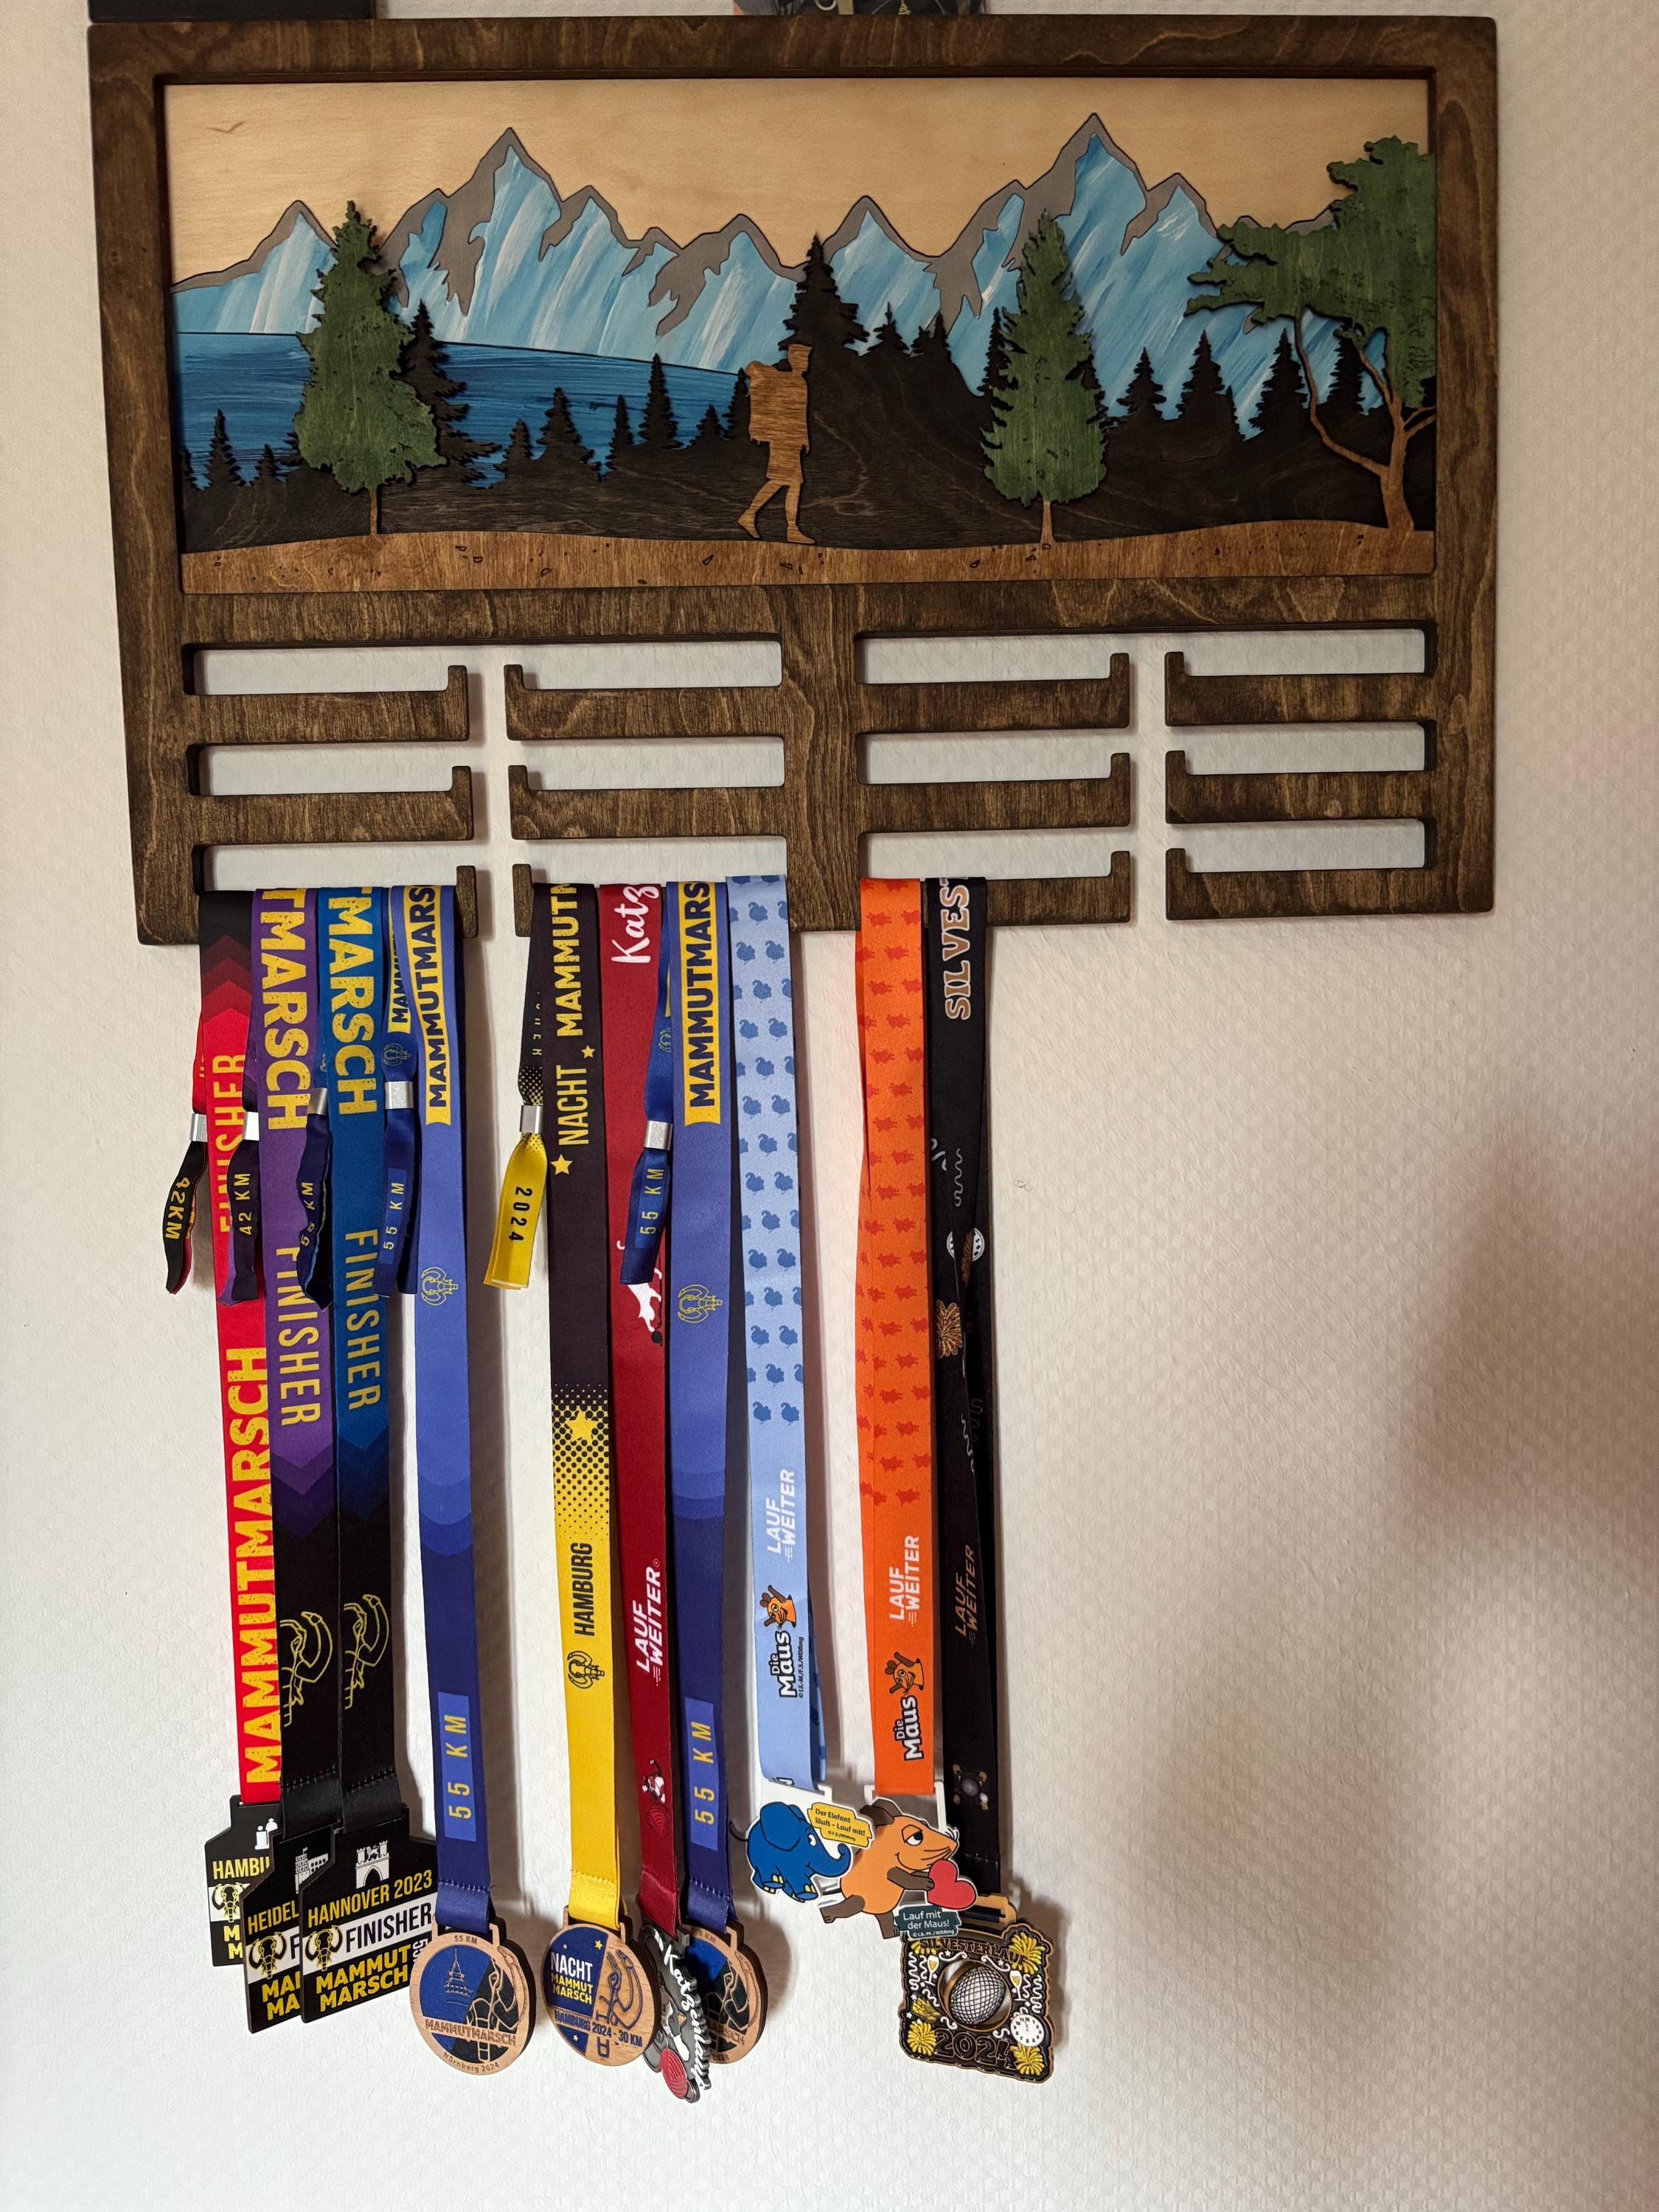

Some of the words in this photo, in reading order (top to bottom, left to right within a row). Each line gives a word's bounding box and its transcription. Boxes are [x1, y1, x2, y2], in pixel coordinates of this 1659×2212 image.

[939, 877, 971, 1020] SILVES
[328, 887, 378, 1115] MARSCH
[408, 885, 447, 1107] MAMMUTMARS
[556, 1065, 589, 1146] NACHT
[234, 1173, 251, 1200] KM
[301, 1182, 316, 1211] KM
[389, 1182, 404, 1210] KM
[644, 1169, 664, 1194] KM
[239, 1211, 252, 1236] 42
[509, 1187, 533, 1242] 2024
[640, 1211, 658, 1234] 55
[383, 1226, 398, 1250] 55
[345, 1229, 380, 1410] FINISHER
[766, 1498, 782, 1554] LAUF
[780, 1469, 796, 1545] WEITER
[226, 1347, 281, 1784] MAMMUTMARSCH
[904, 1535, 920, 1610] WEITER
[571, 1543, 595, 1637] HAMBURG
[888, 1566, 905, 1620] LAUF
[955, 1572, 967, 1637] LAUF
[965, 1545, 978, 1631] WEITER
[633, 1600, 650, 1674] LAUF
[769, 1653, 781, 1675] Die
[776, 1630, 797, 1697] Maus
[444, 1714, 468, 1758] KM
[691, 1721, 714, 1764] KM
[894, 1719, 905, 1740] Die
[901, 1695, 923, 1761] Maus
[448, 1782, 472, 1819] 55
[694, 1787, 714, 1826] 55
[815, 1808, 827, 1816] Der
[828, 1811, 851, 1823] Elefant
[815, 1817, 831, 1827] läuft
[837, 1823, 852, 1832] Lauf
[852, 1828, 866, 1836] mit!
[308, 1884, 389, 1928] HANNOVER
[394, 1870, 433, 1899] 2023
[903, 1910, 924, 1920] Lauf
[926, 1910, 942, 1919] mit
[346, 1902, 432, 1952] FINISHER
[466, 1935, 478, 1945] KM
[908, 1921, 922, 1930] der
[924, 1919, 950, 1928] Maus!
[316, 1944, 411, 1994] MAMMUT
[320, 1964, 408, 2012] MARSCH
[551, 1952, 593, 1982] NACHT
[551, 1972, 594, 1994] MAMMUT
[552, 1983, 592, 2005] MARSCH
[425, 2018, 516, 2046] MAMMUTMARSCH
[554, 2008, 591, 2032] HAMBURG
[592, 2022, 612, 2038] 2024
[619, 2031, 627, 2044] 30
[630, 2034, 643, 2048] KM
[934, 2028, 1017, 2070] 2024
[481, 2062, 500, 2072] 2024
